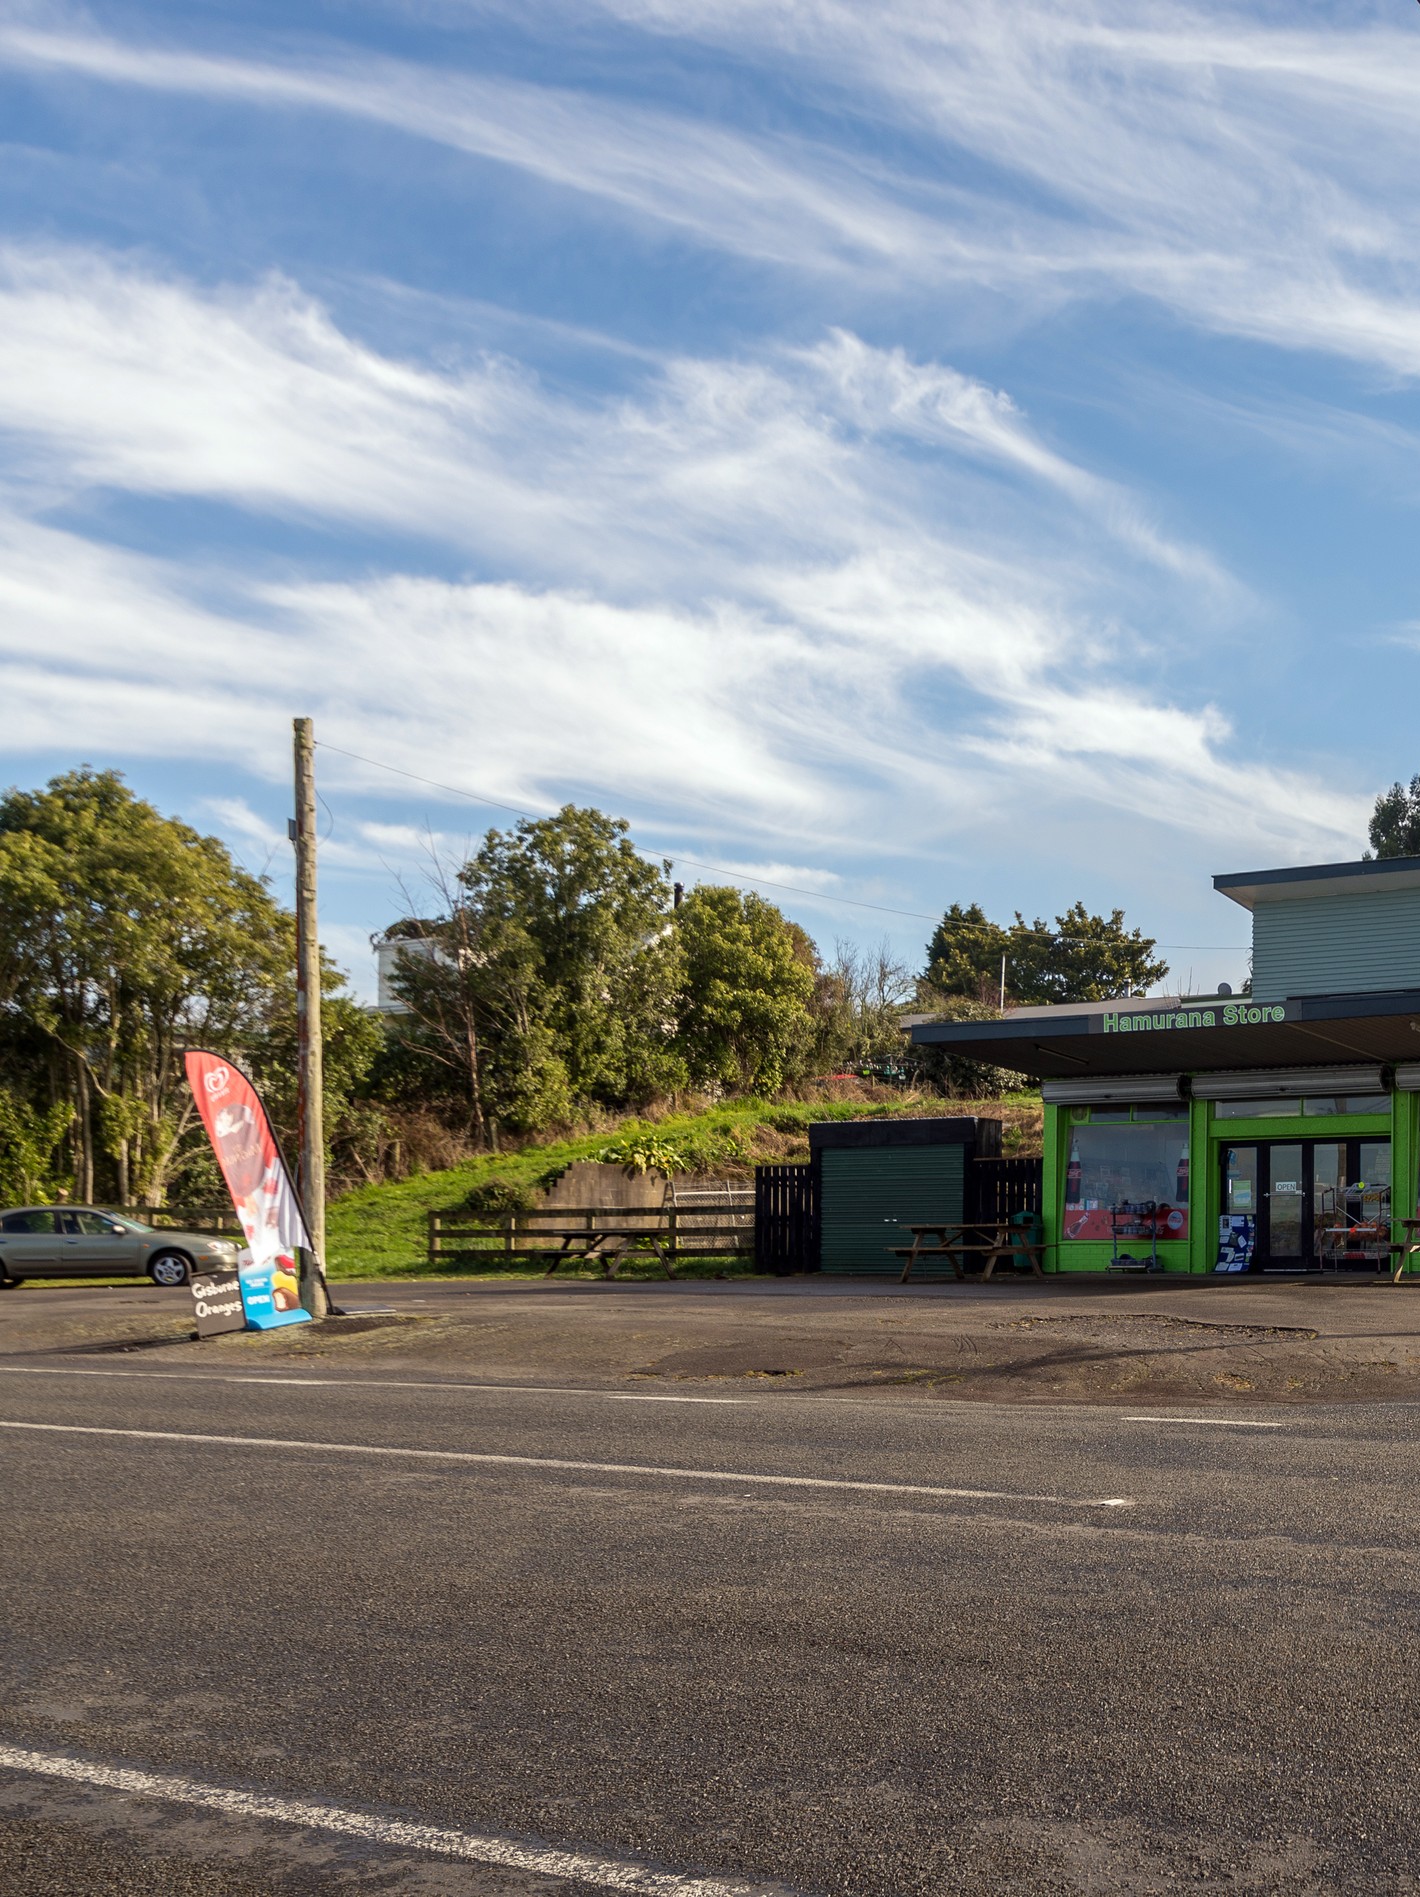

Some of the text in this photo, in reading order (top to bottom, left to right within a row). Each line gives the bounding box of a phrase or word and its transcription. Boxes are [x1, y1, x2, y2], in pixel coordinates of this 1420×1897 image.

[1103, 1004, 1286, 1033] Hamurana Store
[1276, 1183, 1296, 1191] OPEN
[191, 1280, 240, 1299] Gisborne
[195, 1300, 243, 1318] Oranges
[246, 1294, 271, 1306] OPEN
